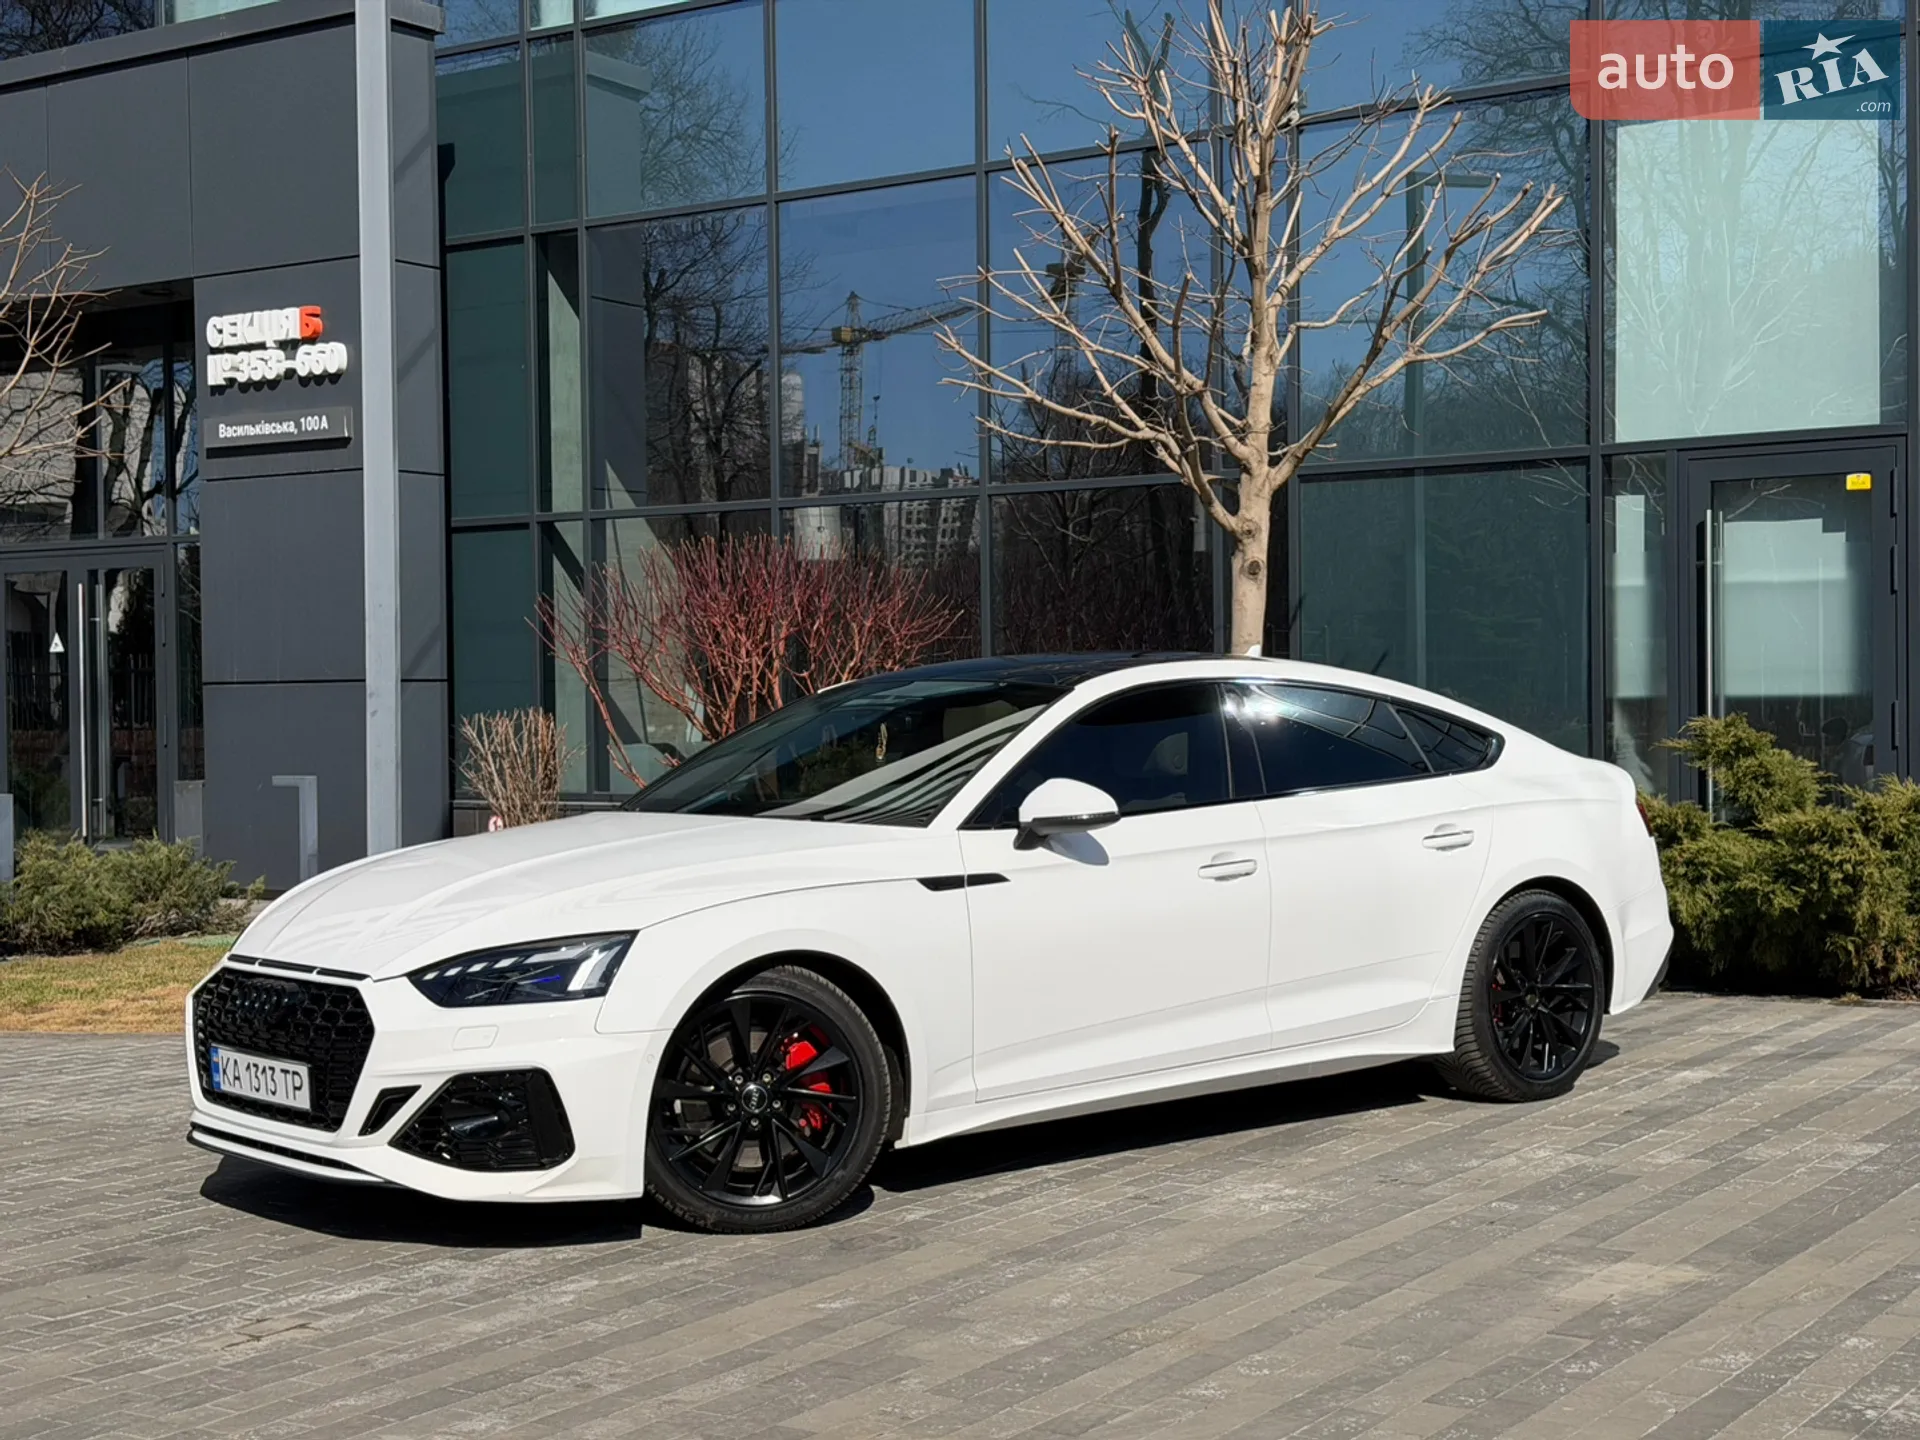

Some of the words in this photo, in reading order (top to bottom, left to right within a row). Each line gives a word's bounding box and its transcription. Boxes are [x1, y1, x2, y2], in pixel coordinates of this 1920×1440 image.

[218, 419, 298, 439] Васильківська,
[221, 1056, 243, 1089] KA
[245, 1062, 278, 1096] 1313
[280, 1069, 303, 1100] TP
